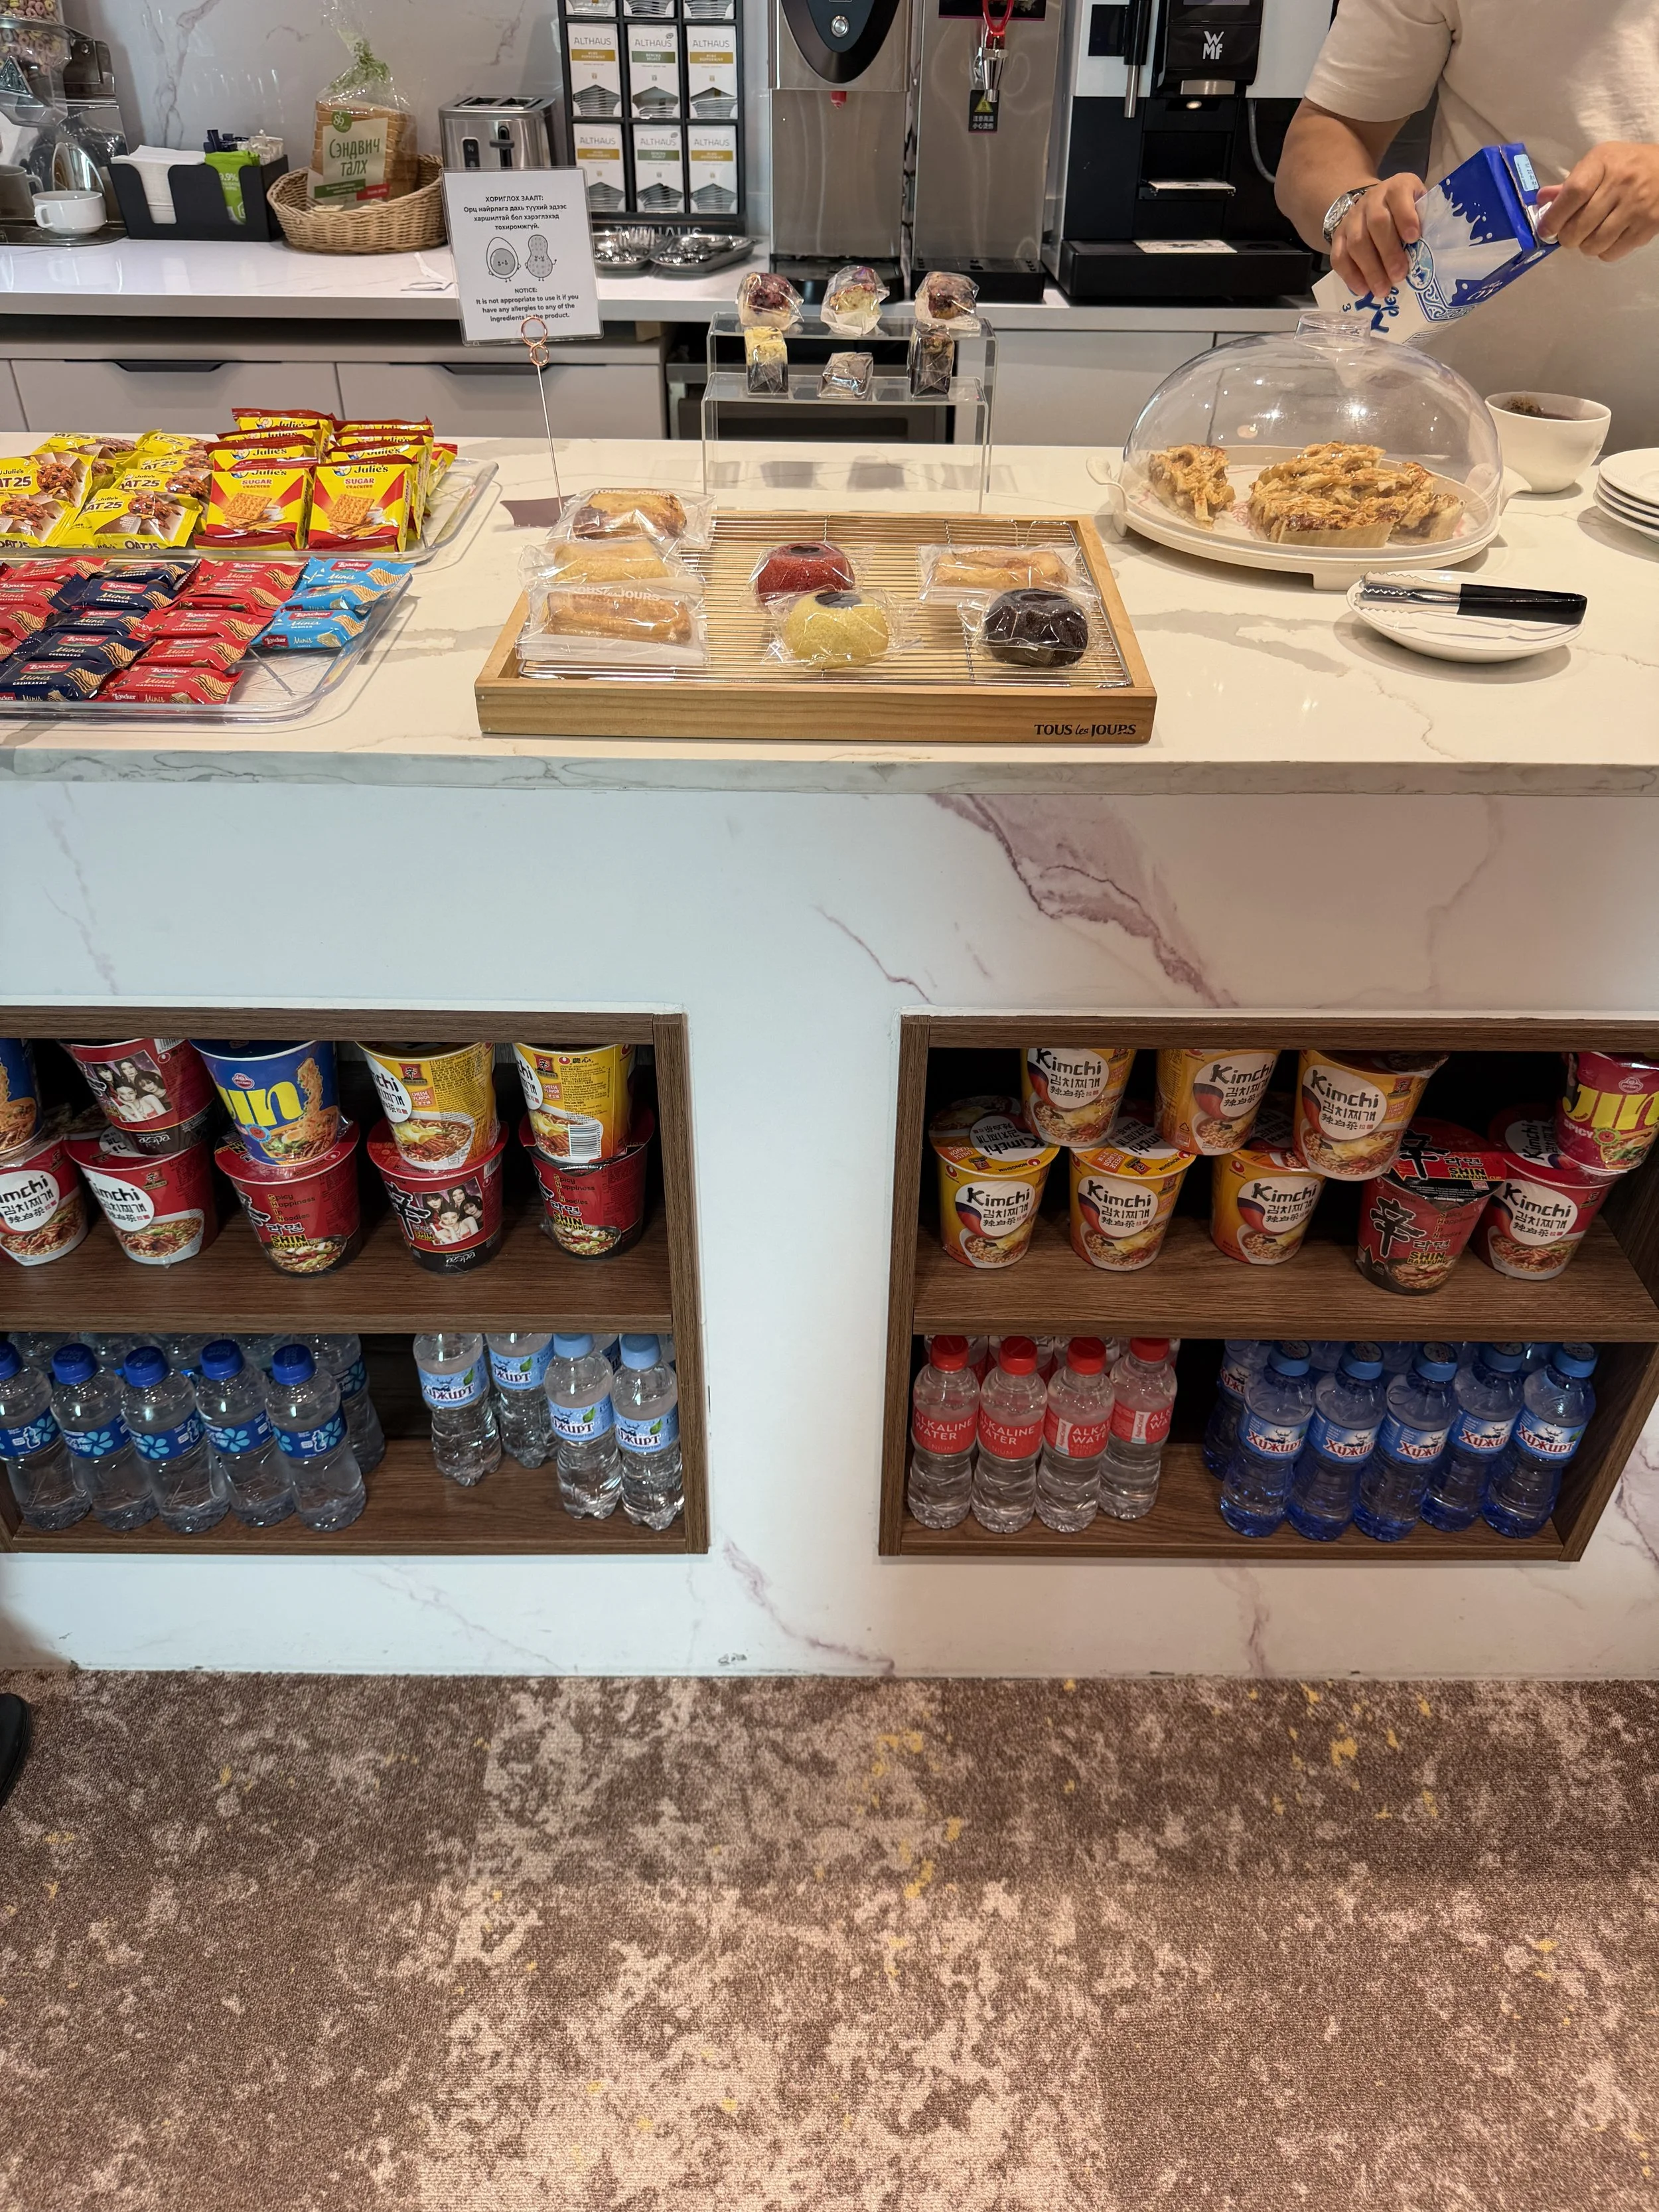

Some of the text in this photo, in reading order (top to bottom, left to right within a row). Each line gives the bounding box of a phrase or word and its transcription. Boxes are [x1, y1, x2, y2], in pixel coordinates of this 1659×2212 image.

[573, 37, 611, 46] ALTHAUS
[634, 38, 672, 47] ALTHAUS
[329, 138, 380, 160] Сэндвич
[340, 159, 368, 177] талх
[354, 465, 389, 474] Julie's
[13, 476, 32, 487] 25
[124, 540, 147, 550] OAT
[619, 589, 662, 601] JOURS
[293, 636, 313, 644] Minis
[144, 694, 165, 703] Minis
[1034, 724, 1137, 737] TOUS les JOURS
[1036, 1048, 1102, 1076] Kimchi
[1209, 1057, 1275, 1085] Kimchi
[1050, 1073, 1100, 1088] 김치찌개
[1311, 1069, 1380, 1108] Kimchi
[218, 1081, 305, 1127] in
[1321, 1100, 1376, 1122] 김치찌개
[1563, 1119, 1594, 1139] SPICY
[948, 1146, 970, 1156] FLAVOR
[983, 1135, 1045, 1156] Kimchi
[953, 1149, 974, 1159] CHEESE
[1443, 1156, 1484, 1167] 라면
[998, 1162, 1028, 1172] NONGSHIM
[1110, 1155, 1125, 1170] CHEESE
[1447, 1167, 1488, 1176] SHIN
[555, 1180, 595, 1191] Happiness
[1086, 1179, 1152, 1207] Kimchi
[1251, 1182, 1318, 1204] Kimchi
[1, 1189, 54, 1216] 김치찌개
[270, 1197, 315, 1208] Happiness
[966, 1187, 1031, 1207] Kimchi
[1502, 1182, 1571, 1218] Kimchi
[549, 1199, 582, 1217] 라면
[983, 1203, 1029, 1218] 김치찌개
[1101, 1205, 1150, 1219] 김치찌개
[1267, 1199, 1313, 1215] 김치찌개
[553, 1211, 583, 1225] SHIN
[1515, 1211, 1568, 1230] 김치찌개
[265, 1222, 305, 1235] 라면
[1370, 1196, 1427, 1259] 辛
[270, 1234, 307, 1244] SHIN
[1413, 1239, 1451, 1252] 라면
[1409, 1251, 1446, 1260] SHIN
[915, 1412, 972, 1432] ALKALINE
[980, 1411, 1035, 1437] ALKALINE
[916, 1422, 958, 1440] WATER
[1072, 1430, 1106, 1444] WATE
[1516, 1424, 1575, 1453] Хужирт
[1324, 1437, 1376, 1457] Хужир
